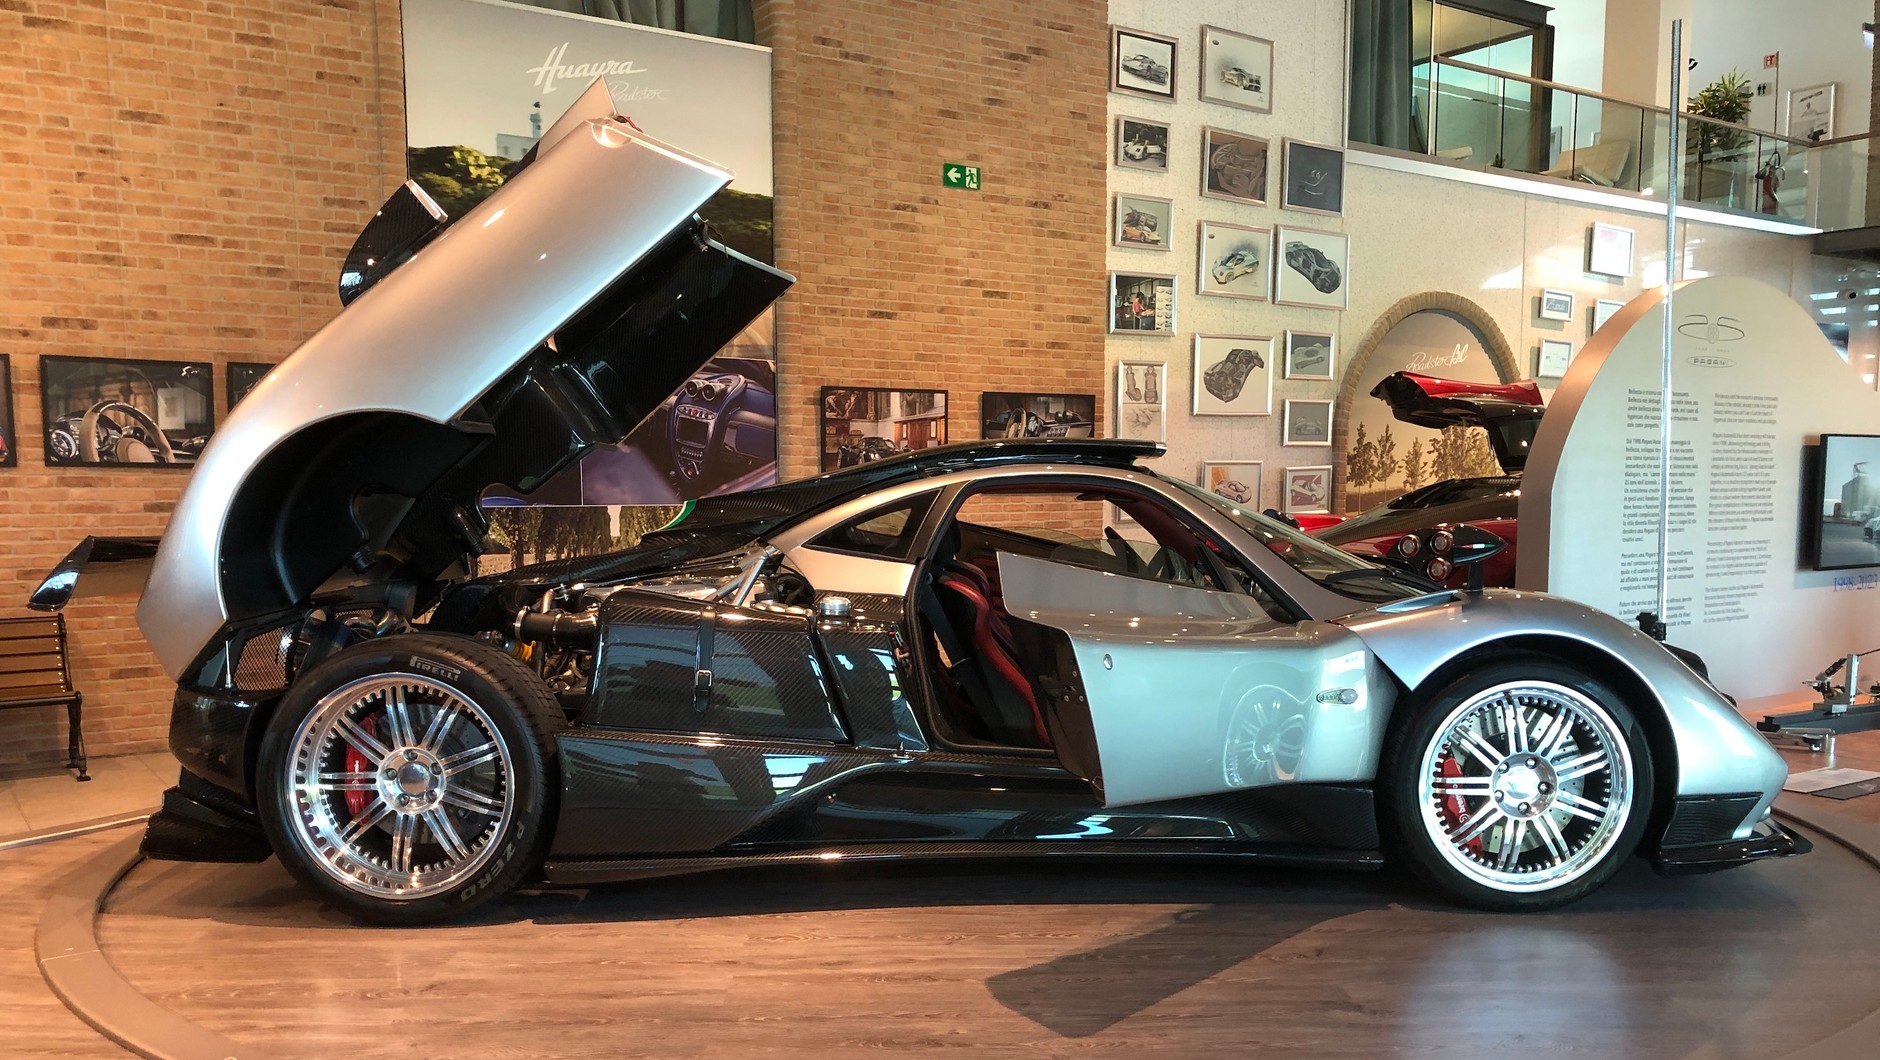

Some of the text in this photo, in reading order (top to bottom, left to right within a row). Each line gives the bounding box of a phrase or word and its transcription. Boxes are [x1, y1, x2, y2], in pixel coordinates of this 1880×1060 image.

[525, 42, 648, 94] Huayra
[409, 655, 462, 682] PIRELLI
[1452, 783, 1466, 814] bremo
